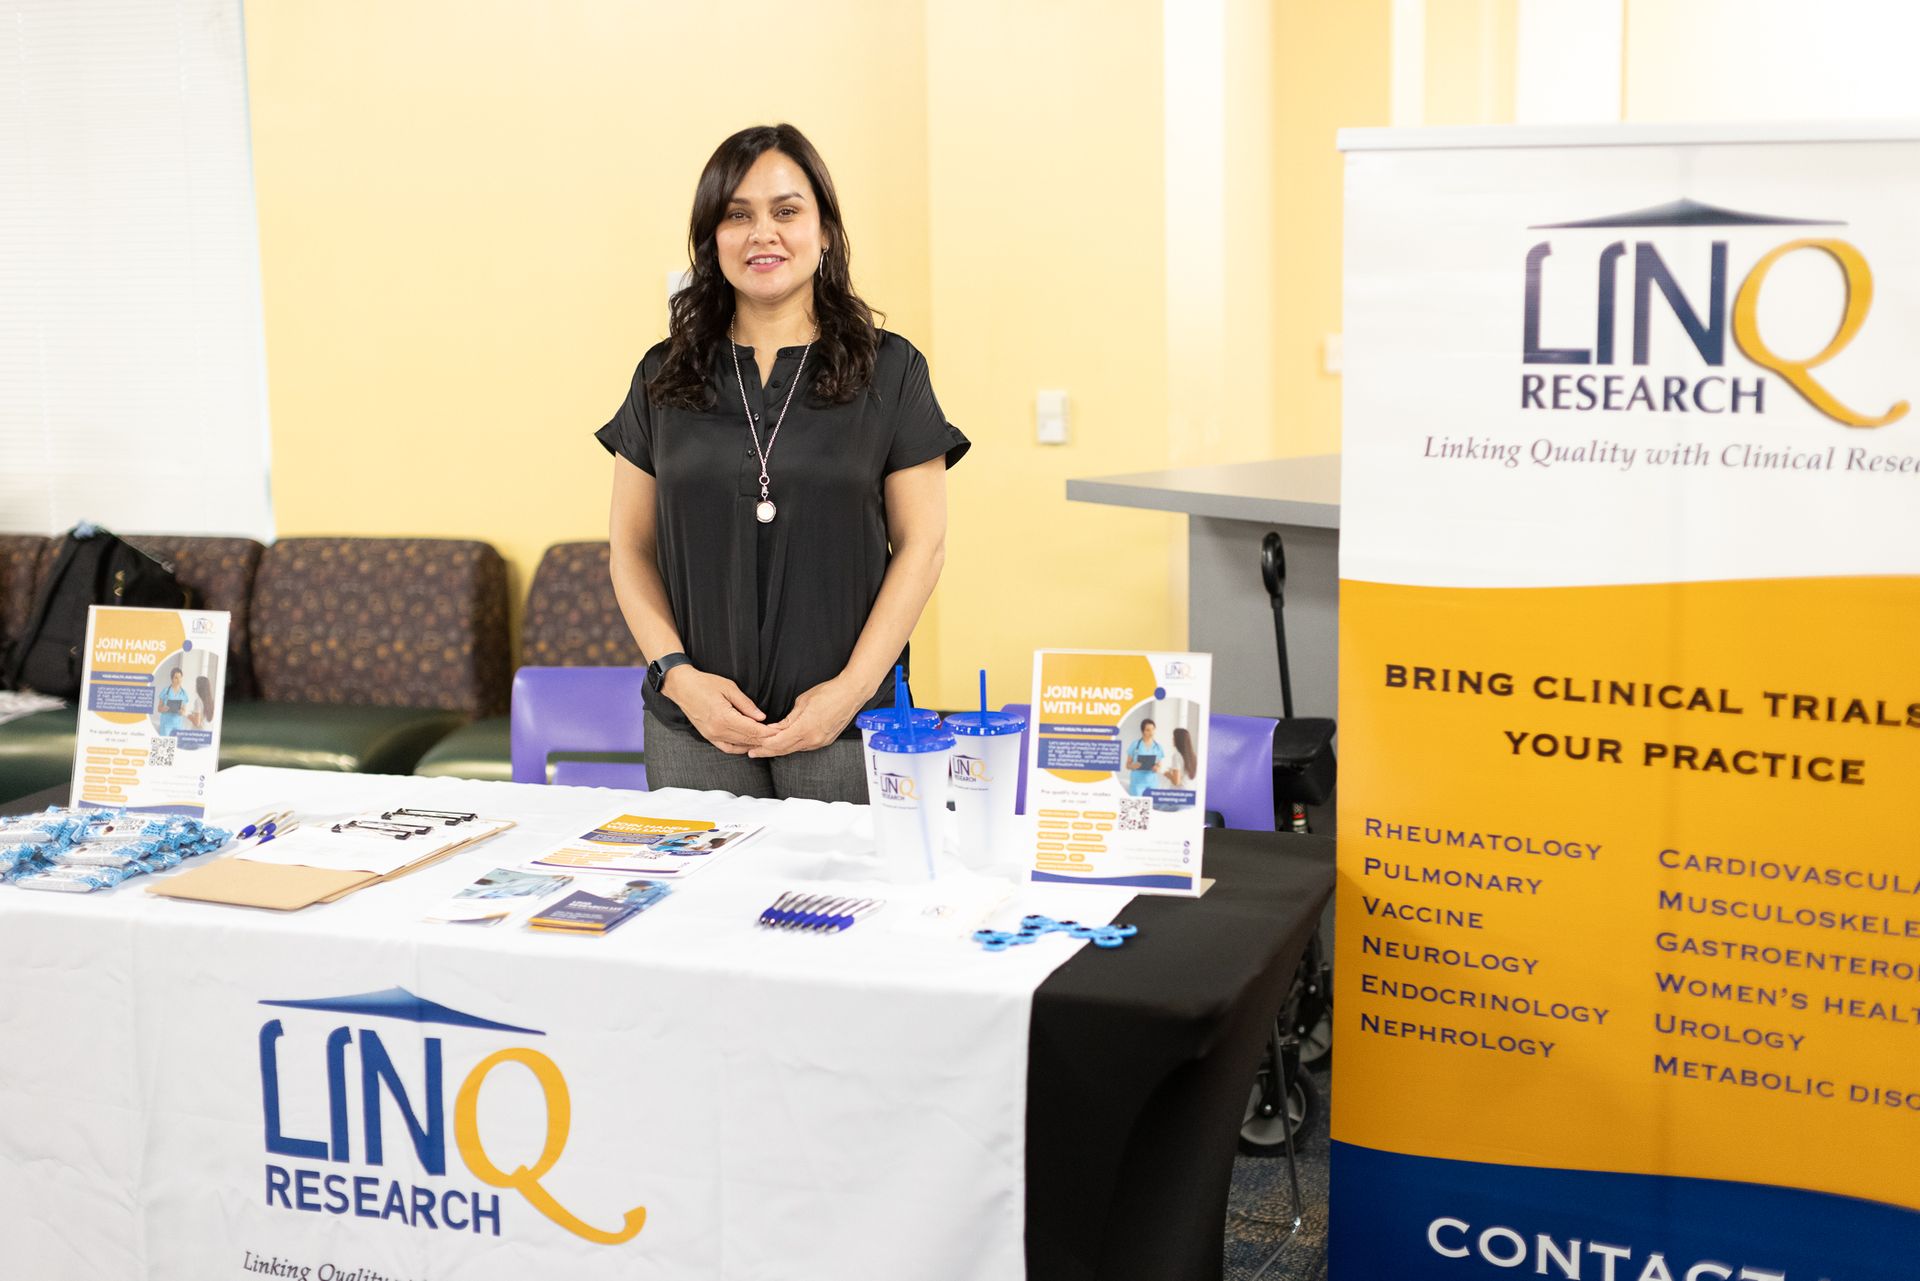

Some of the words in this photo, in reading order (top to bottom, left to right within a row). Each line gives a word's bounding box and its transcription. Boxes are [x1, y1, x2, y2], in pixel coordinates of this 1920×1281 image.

[1522, 237, 1911, 429] LINQ
[1520, 373, 1766, 415] RESEARCH
[1424, 436, 1522, 468] Linking
[1530, 438, 1636, 471] Quality
[1646, 443, 1710, 467] with
[1721, 443, 1835, 471] Clinical
[95, 651, 126, 663] WITH
[96, 638, 123, 649] JOIN
[126, 640, 167, 651] HANDS
[1043, 686, 1078, 699] JOIN
[1081, 687, 1134, 701] HANDS
[1043, 701, 1083, 714] WITH
[1086, 702, 1121, 716] LINQ
[1385, 664, 1514, 697] BRING
[1533, 676, 1744, 715] CLINICAL
[1763, 691, 1920, 729] TRIALS
[1504, 731, 1623, 764] YOUR
[1643, 743, 1866, 785] PRACTICE
[1365, 818, 1603, 861] RHEUMATOLOGY
[1364, 858, 1543, 895] PULMONARY
[1362, 896, 1484, 930] VACCINE
[1362, 935, 1539, 976] NEUROLOGY
[1656, 932, 1920, 982] GASTROENTERO
[1362, 974, 1610, 1025] ENDOCRINOLOGY
[1656, 973, 1809, 1010] WOMEN'S
[1361, 1013, 1555, 1058] NEPHROLOGY
[1654, 1014, 1806, 1051] UROLOGY
[1654, 1054, 1835, 1099] METABOLIC
[259, 1019, 647, 1246] LINQ
[265, 1164, 500, 1236] RESEARCH
[243, 1251, 311, 1281] Linking
